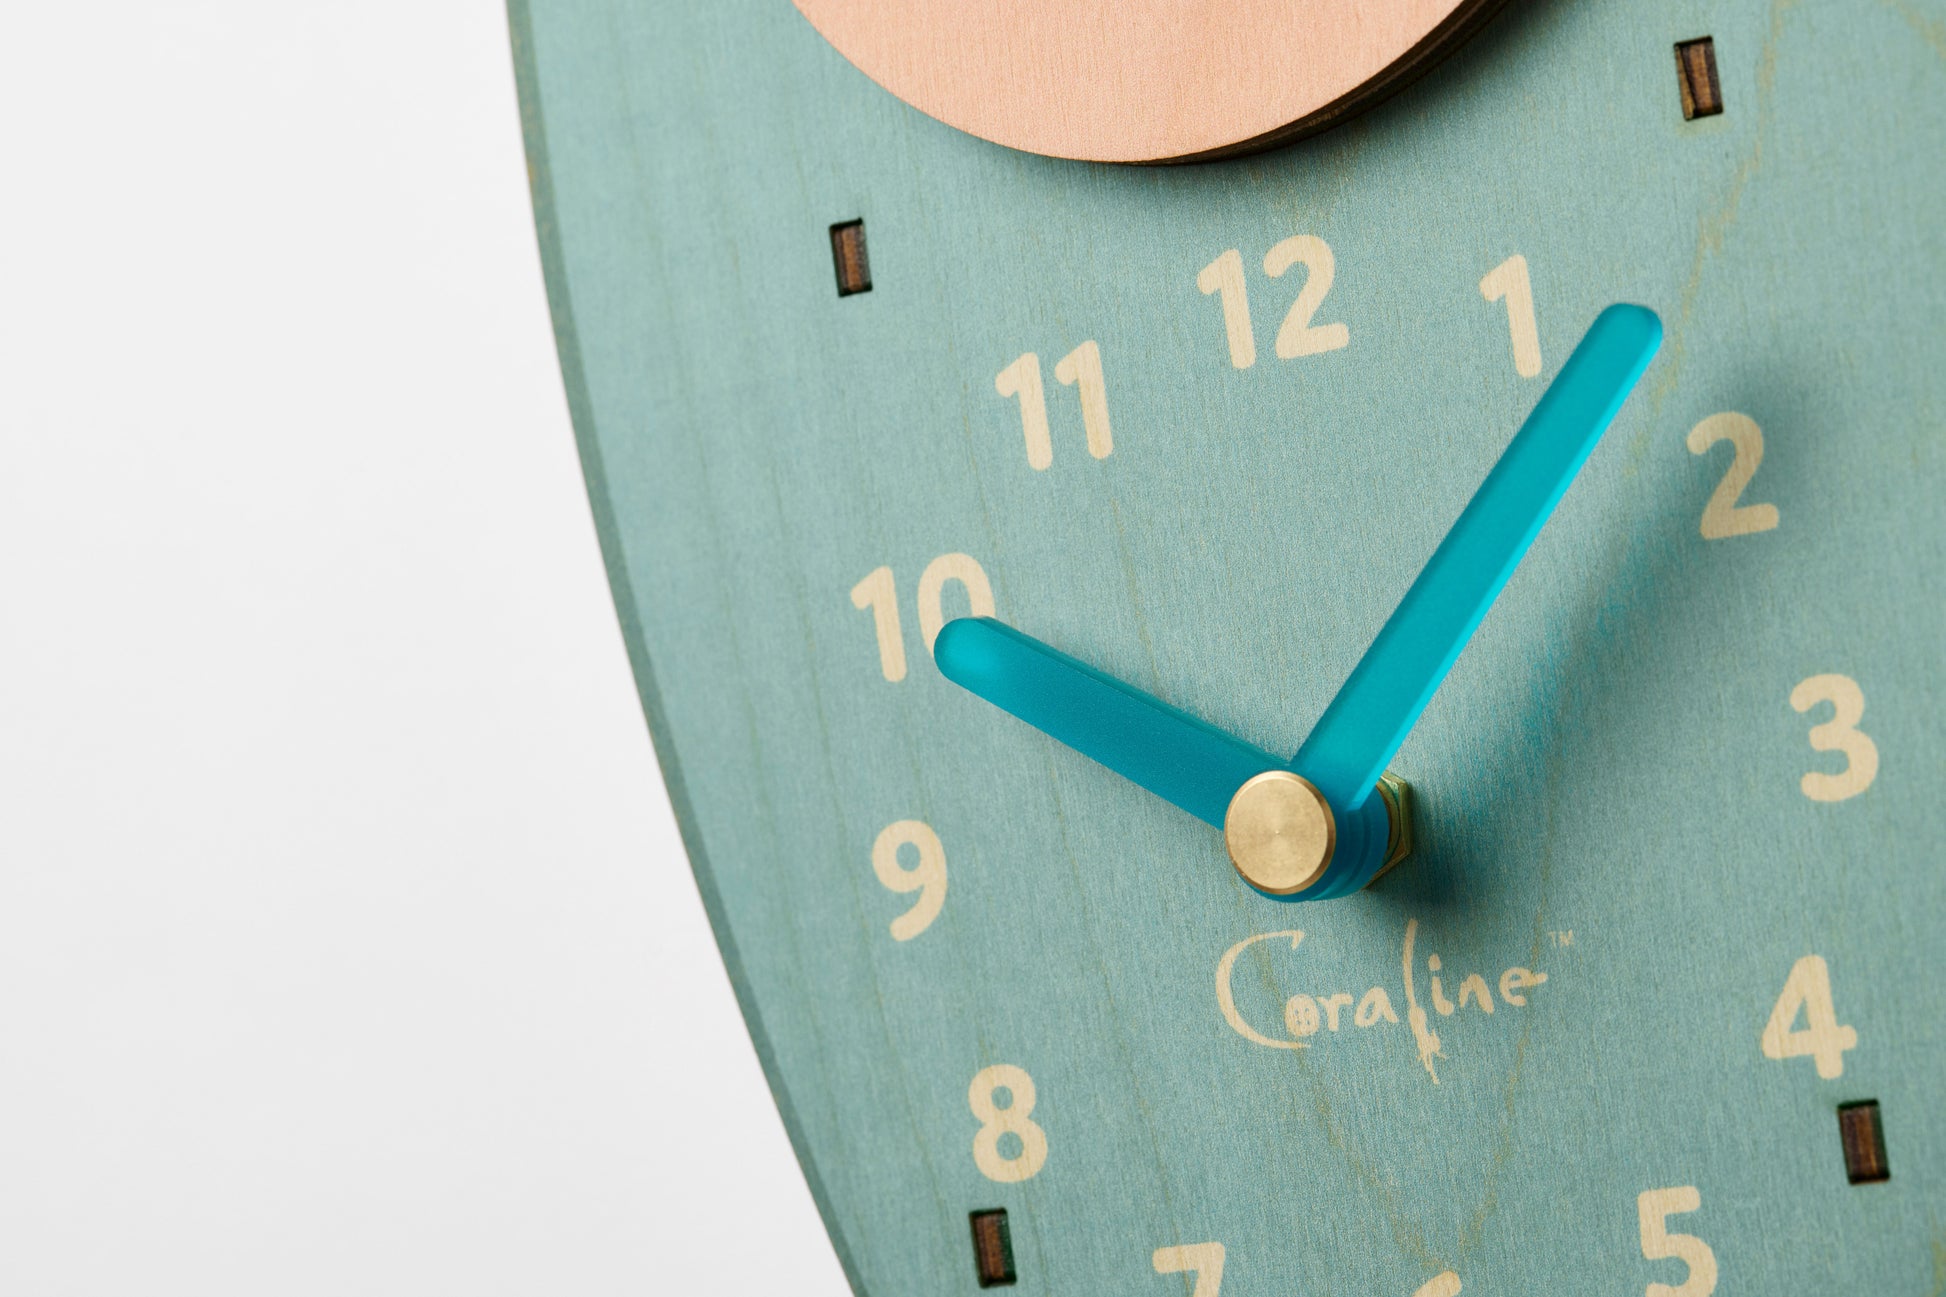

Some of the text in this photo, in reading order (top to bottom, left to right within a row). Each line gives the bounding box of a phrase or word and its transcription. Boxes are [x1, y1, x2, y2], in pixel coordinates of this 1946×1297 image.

[1197, 235, 1350, 371] 12
[1480, 254, 1542, 380] 1
[996, 340, 1115, 471] 11
[1685, 411, 1781, 541] 2
[850, 551, 996, 684] 10
[1789, 673, 1879, 804] 3
[871, 819, 948, 943] 9
[1215, 918, 1549, 1084] Coraline
[1762, 954, 1858, 1079] 4
[968, 1064, 1050, 1182] 8
[1637, 1185, 1718, 1297] 5
